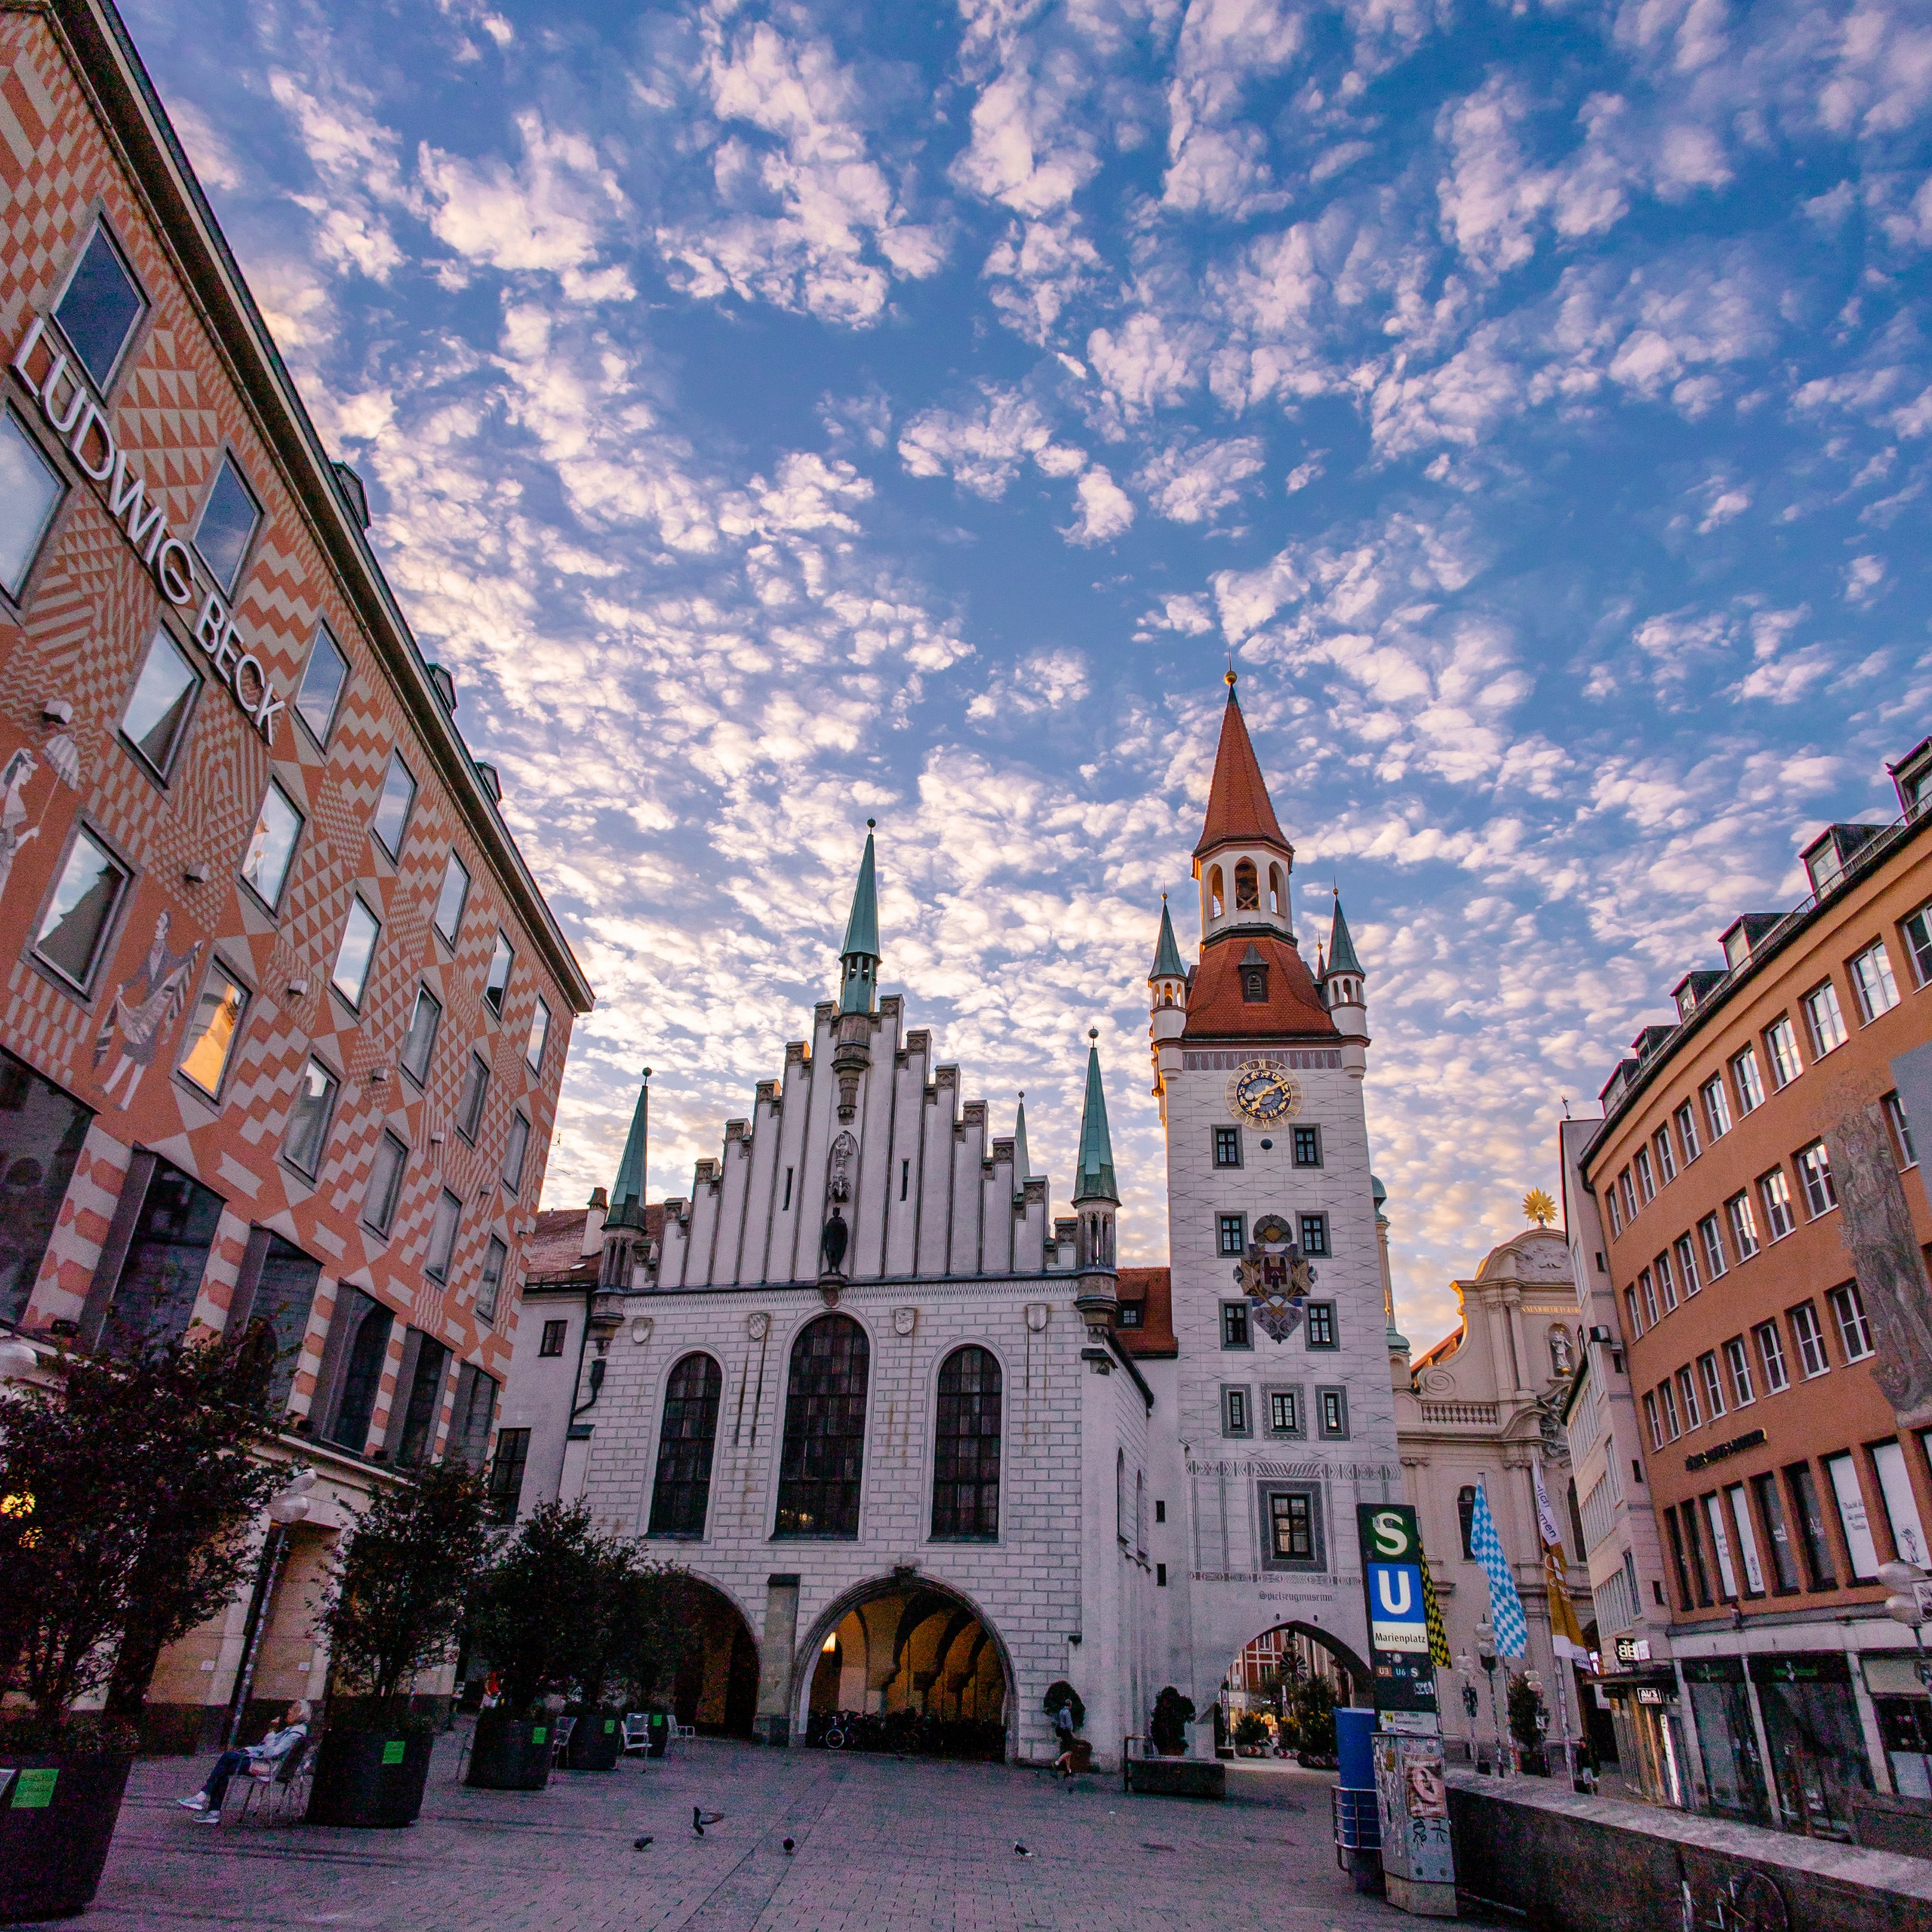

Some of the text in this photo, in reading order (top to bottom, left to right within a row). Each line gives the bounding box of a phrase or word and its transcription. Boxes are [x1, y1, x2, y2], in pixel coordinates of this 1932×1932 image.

[13, 317, 285, 746] LUDWIG BECK
[1374, 1512, 1407, 1555] S
[1258, 1590, 1333, 1603] Spielzeugmuseum
[1378, 1570, 1411, 1614] U
[1375, 1632, 1426, 1644] Marienplatz
[1379, 1666, 1389, 1675] U3
